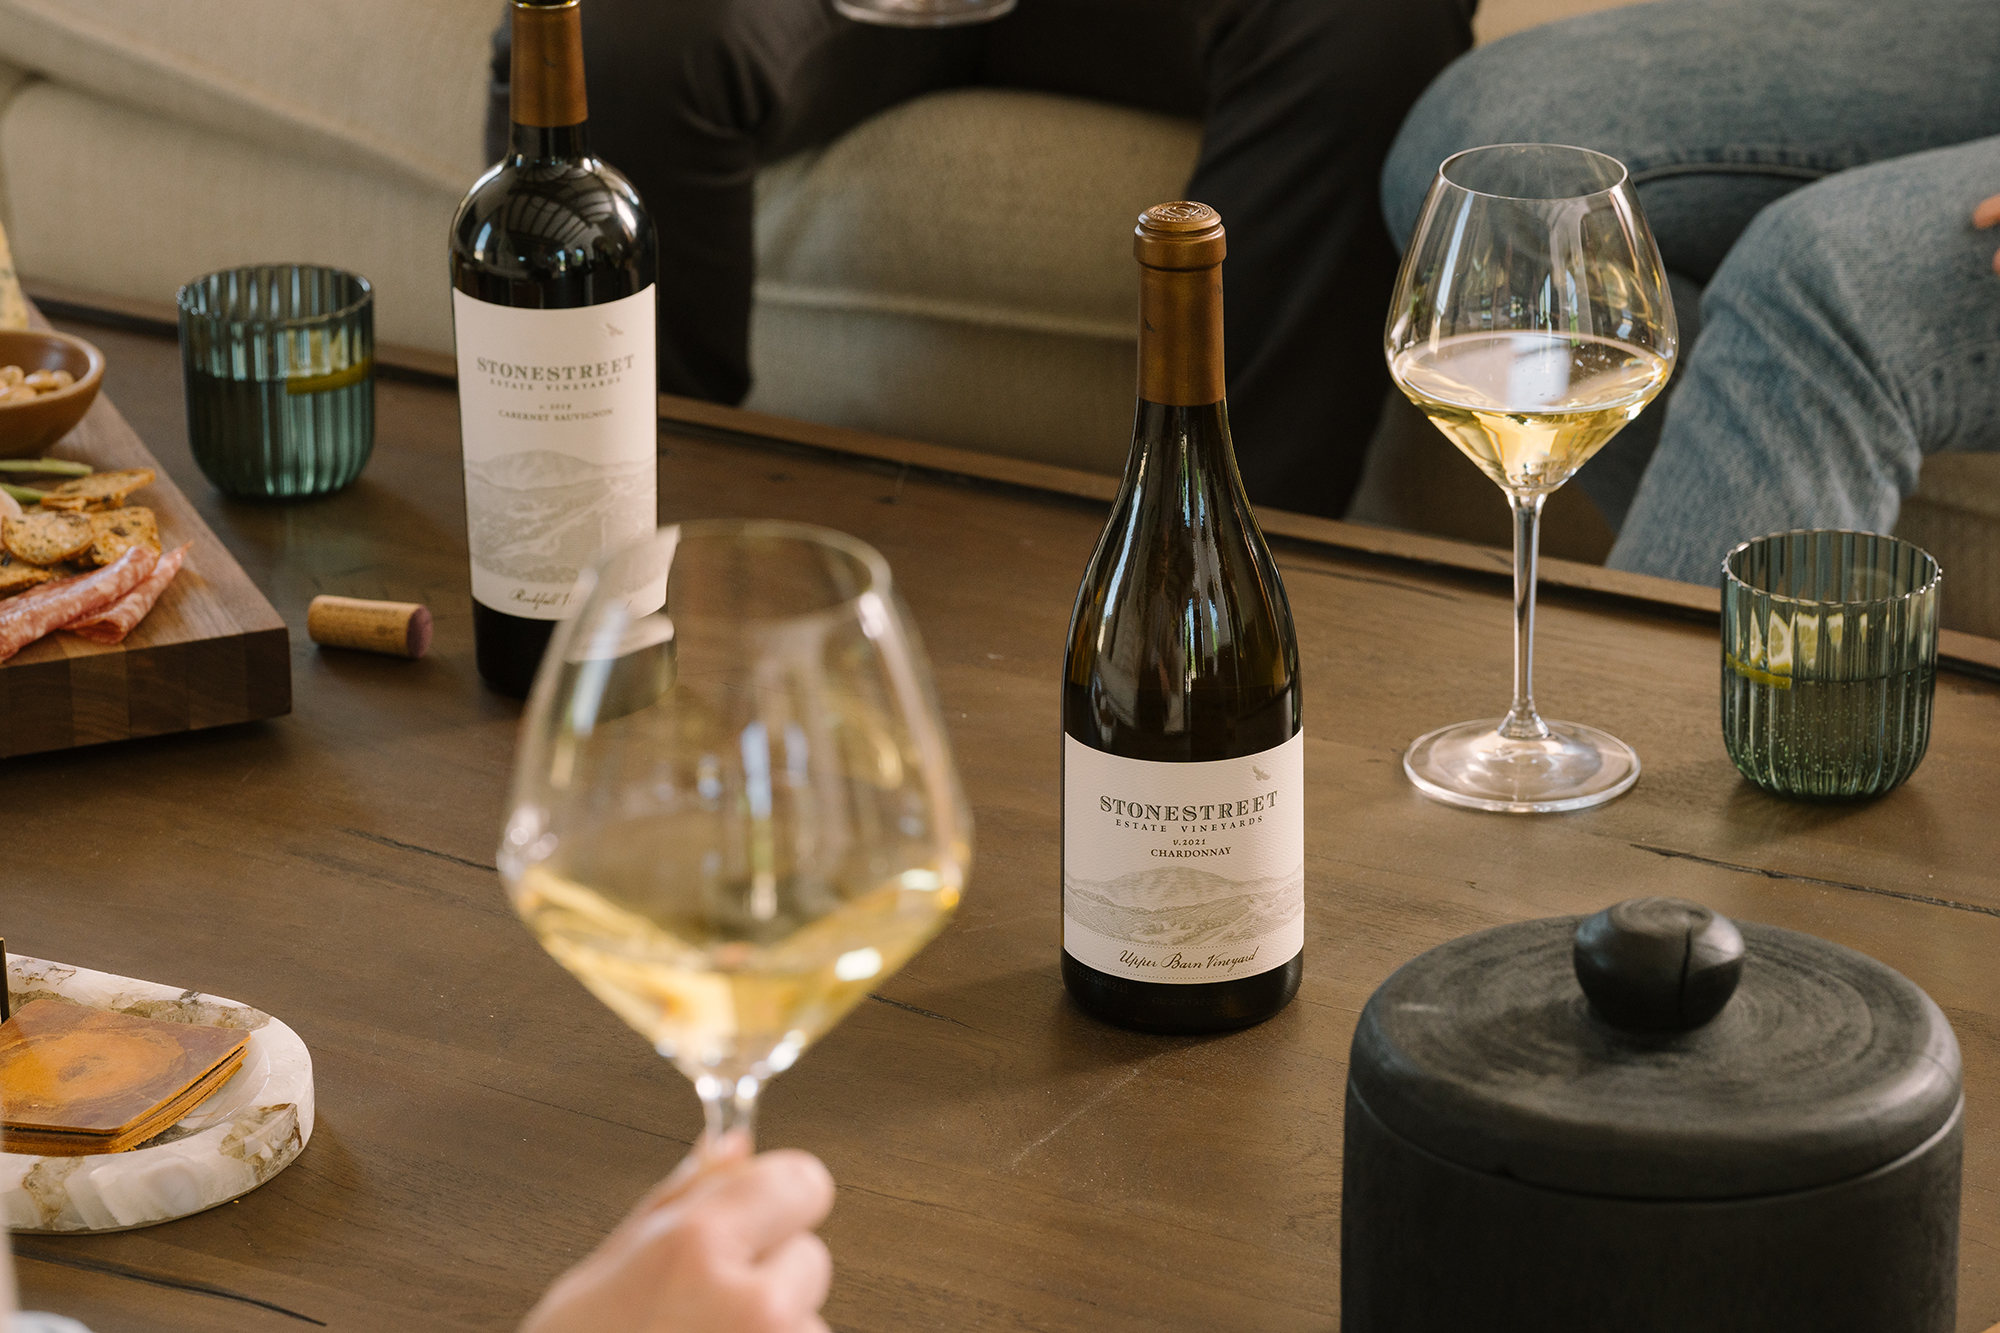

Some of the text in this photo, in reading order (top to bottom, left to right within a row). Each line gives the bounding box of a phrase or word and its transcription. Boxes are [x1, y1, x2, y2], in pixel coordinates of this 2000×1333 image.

[477, 354, 634, 381] STONESTREET
[490, 377, 621, 391] ESTATE VINEYARDS
[498, 408, 613, 422] CABERNET SAUVIGNON
[1100, 790, 1278, 822] STONESTREET
[1115, 815, 1263, 833] ESTATE VINEYARDS
[1151, 847, 1231, 858] CHARDONNAY
[1119, 945, 1260, 973] Upper Barn Vineyard
